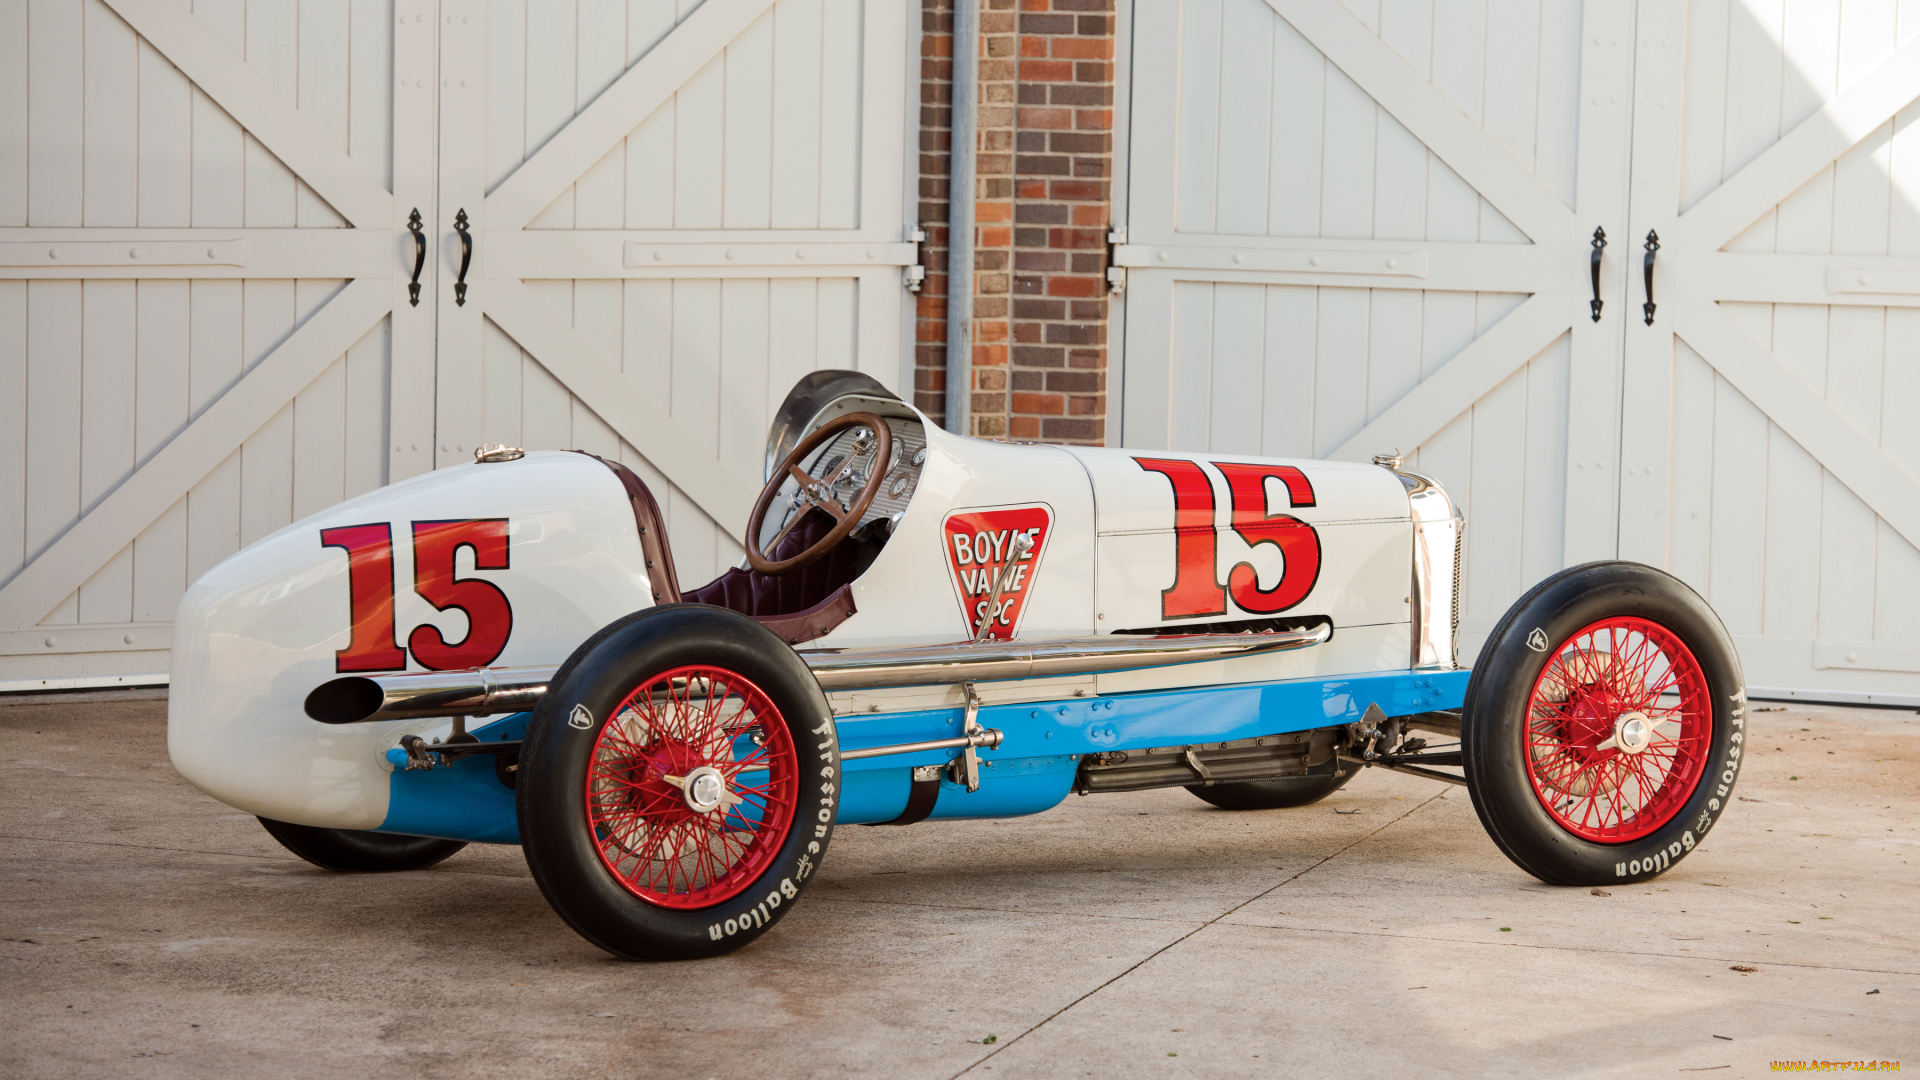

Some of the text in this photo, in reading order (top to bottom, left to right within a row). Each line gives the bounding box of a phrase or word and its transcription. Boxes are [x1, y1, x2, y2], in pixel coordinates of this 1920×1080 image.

[319, 517, 513, 674] 15
[1129, 456, 1322, 621] 15
[708, 717, 836, 941] Firestone Balloon
[1615, 687, 1745, 877] Firestone Balloon
